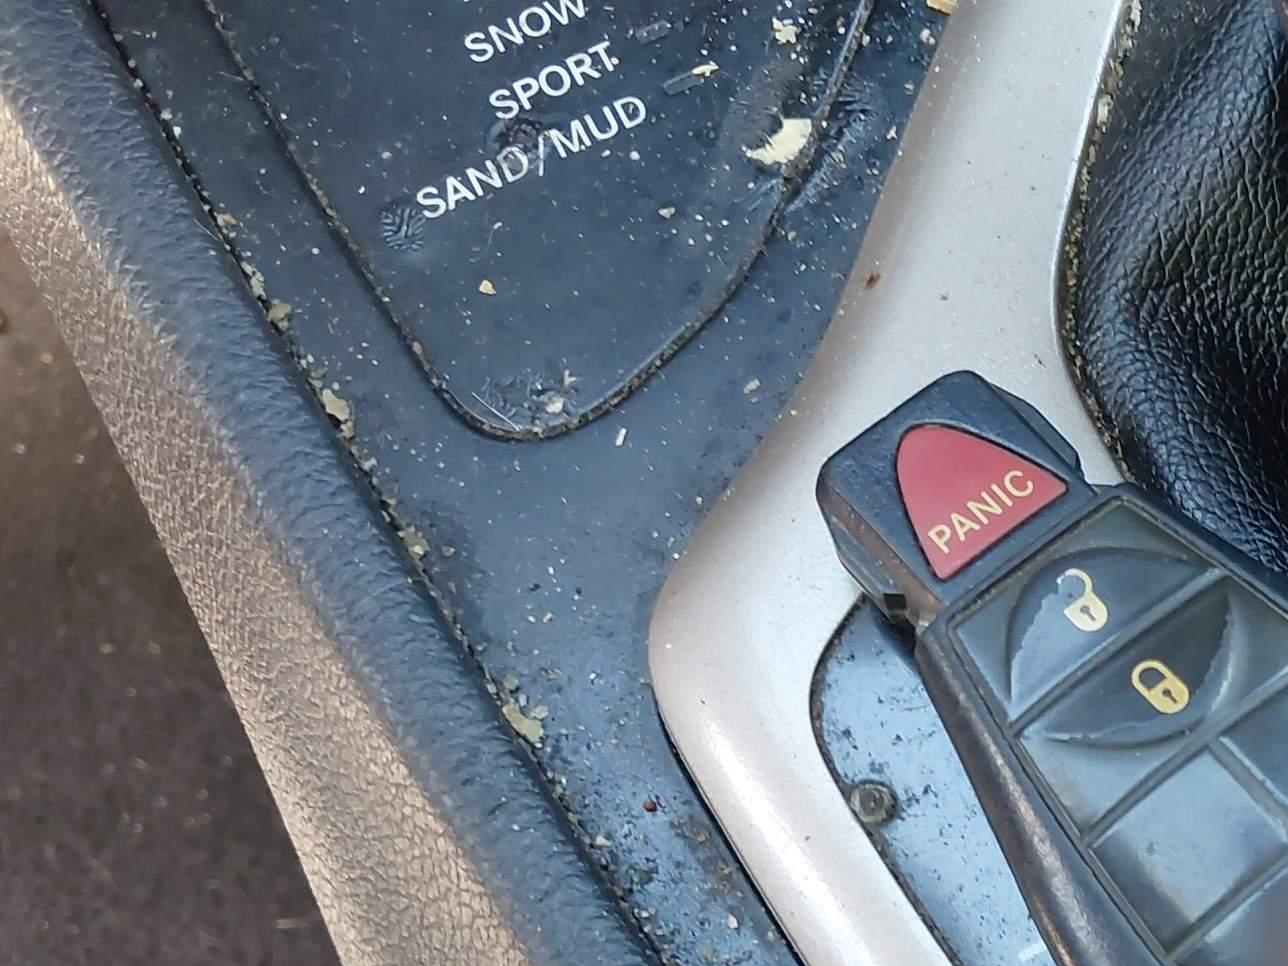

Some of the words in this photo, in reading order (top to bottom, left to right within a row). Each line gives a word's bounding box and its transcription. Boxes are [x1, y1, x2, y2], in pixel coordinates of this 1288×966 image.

[464, 0, 587, 62] SNOW
[489, 41, 615, 119] SPORT
[416, 96, 648, 218] SAND/MUD
[927, 470, 1034, 554] PANIC
